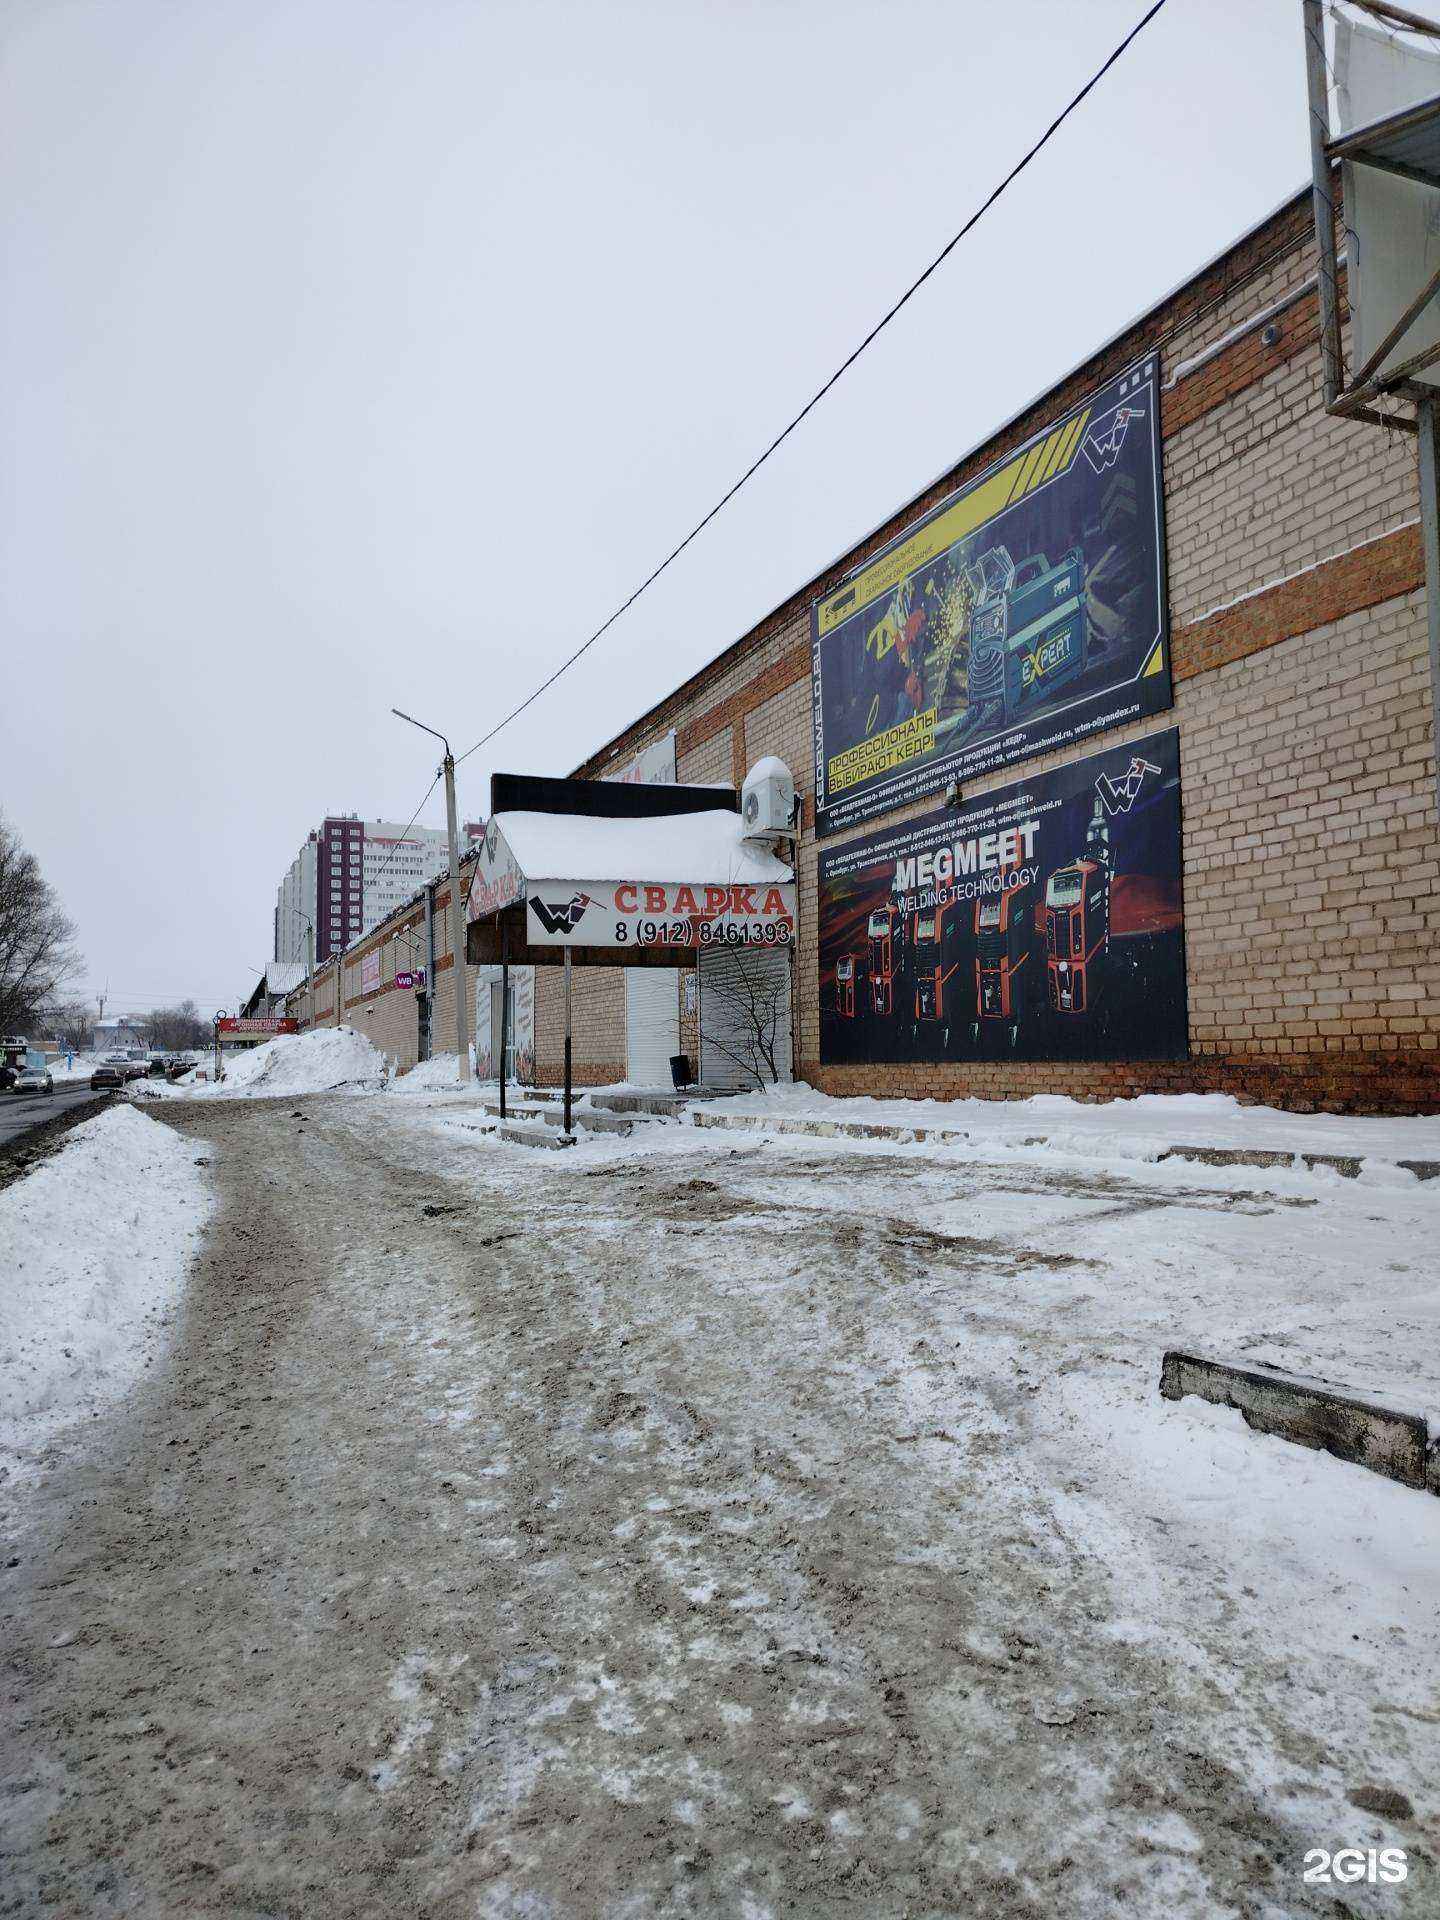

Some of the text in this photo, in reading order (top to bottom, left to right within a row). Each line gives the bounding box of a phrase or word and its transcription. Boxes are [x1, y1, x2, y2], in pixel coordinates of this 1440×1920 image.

[829, 707, 938, 772] ПРОФЕССИОНАЛЫ
[829, 734, 935, 791] ВЫБИРАЮТ КЕДР!
[917, 758, 963, 783] ДИСТРИБЬЮТОР
[963, 743, 1002, 765] ПРОДУКЦИИ
[957, 807, 994, 827] ПРОДУКЦИИ
[894, 820, 1040, 892] MEGMEET
[614, 885, 788, 915] СВАРКА
[898, 866, 1040, 913] WELDING TECHNOLOGY
[615, 918, 791, 947] 8 (912) 8461393
